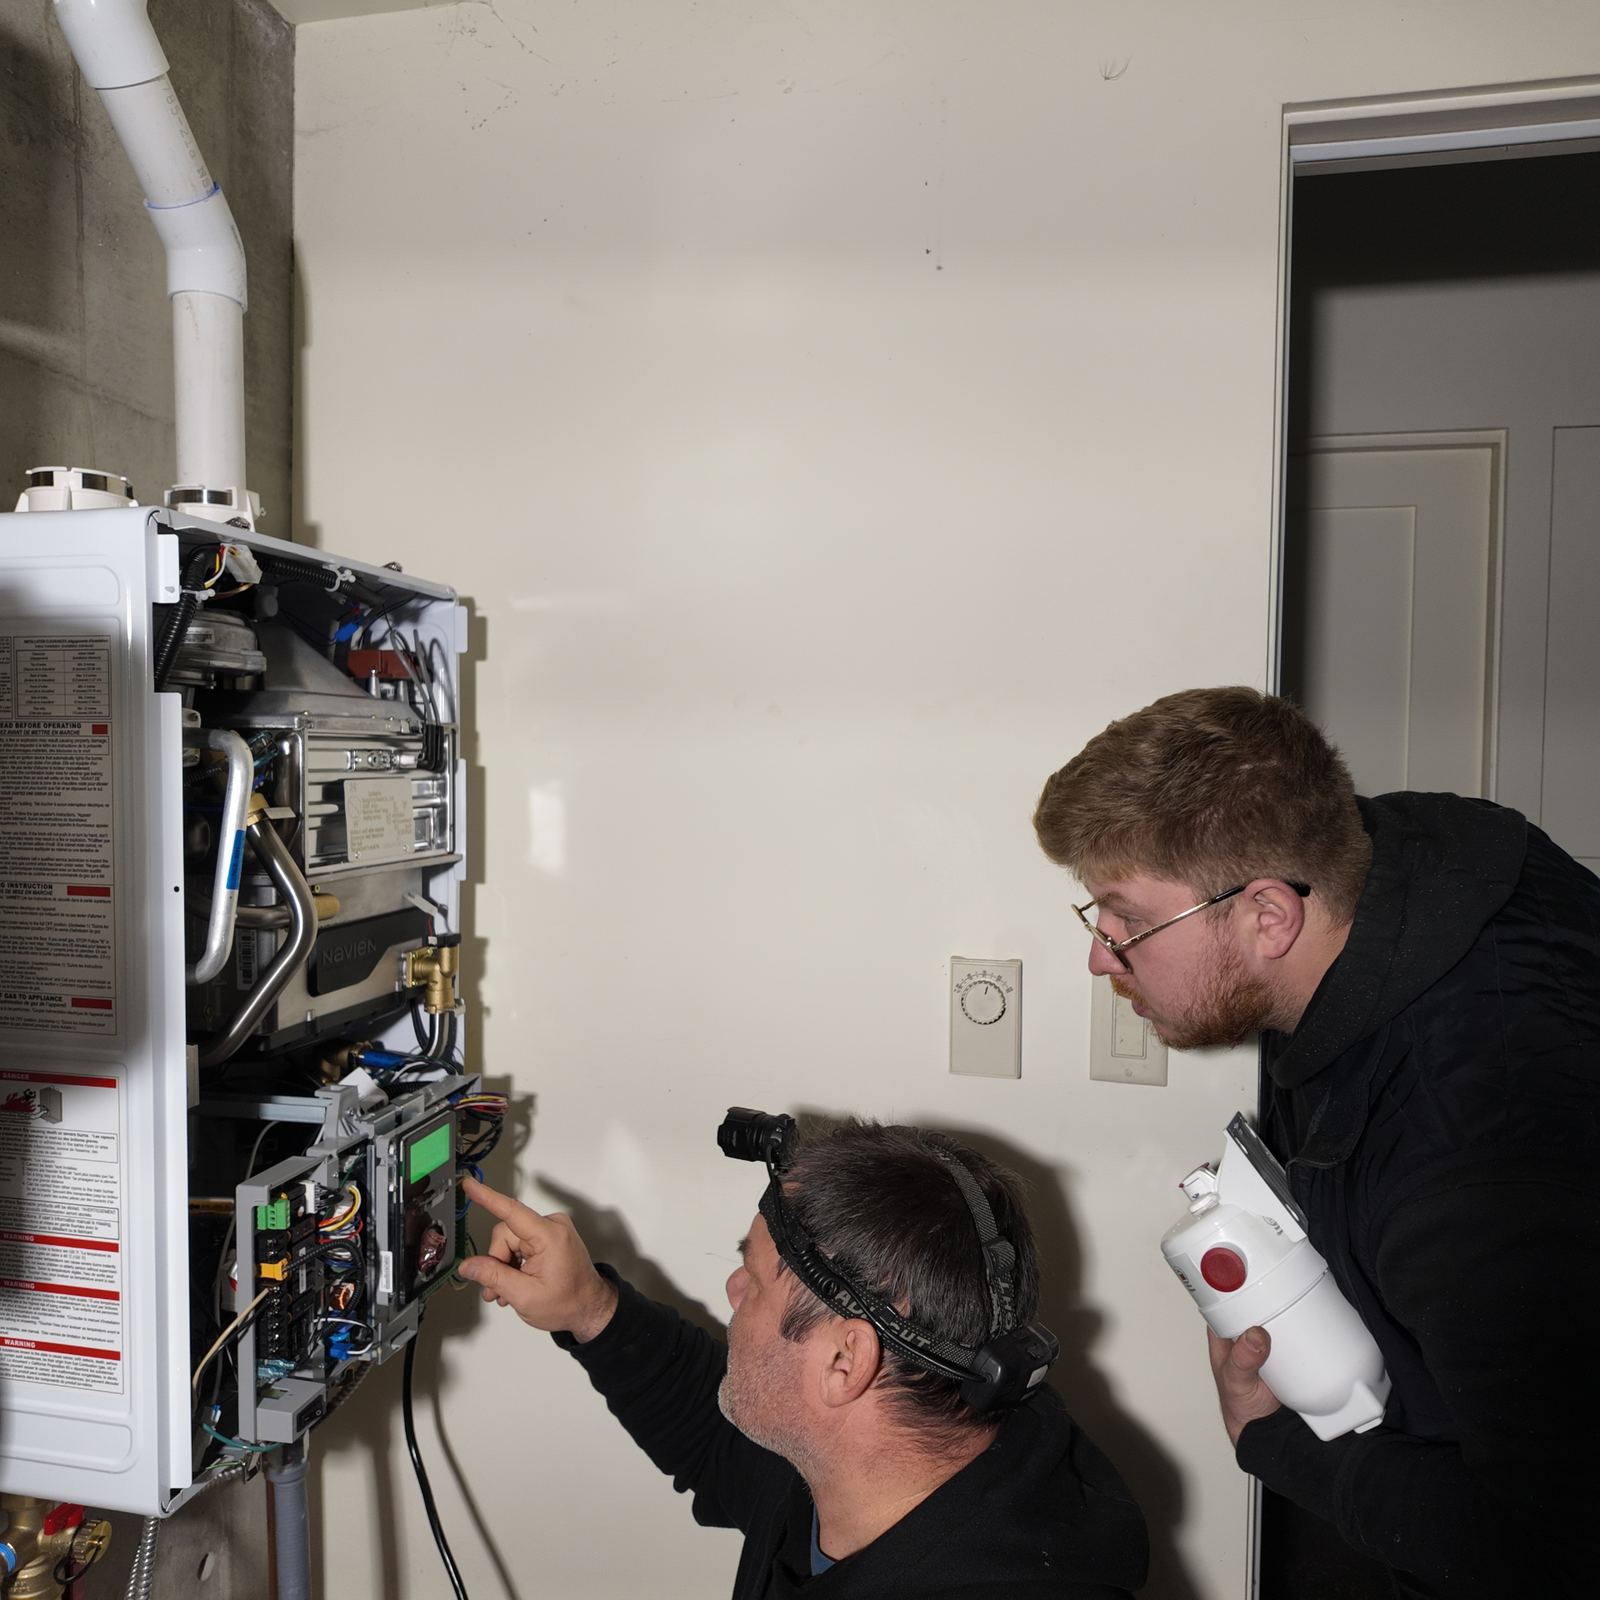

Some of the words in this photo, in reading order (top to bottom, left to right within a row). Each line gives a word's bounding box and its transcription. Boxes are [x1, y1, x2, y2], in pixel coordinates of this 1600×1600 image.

[28, 994, 63, 1002] APPLIANCE
[2, 1072, 29, 1080] DANGER
[3, 1233, 35, 1241] WARNING
[4, 1280, 35, 1290] WARNING
[4, 1338, 36, 1349] WARNING
